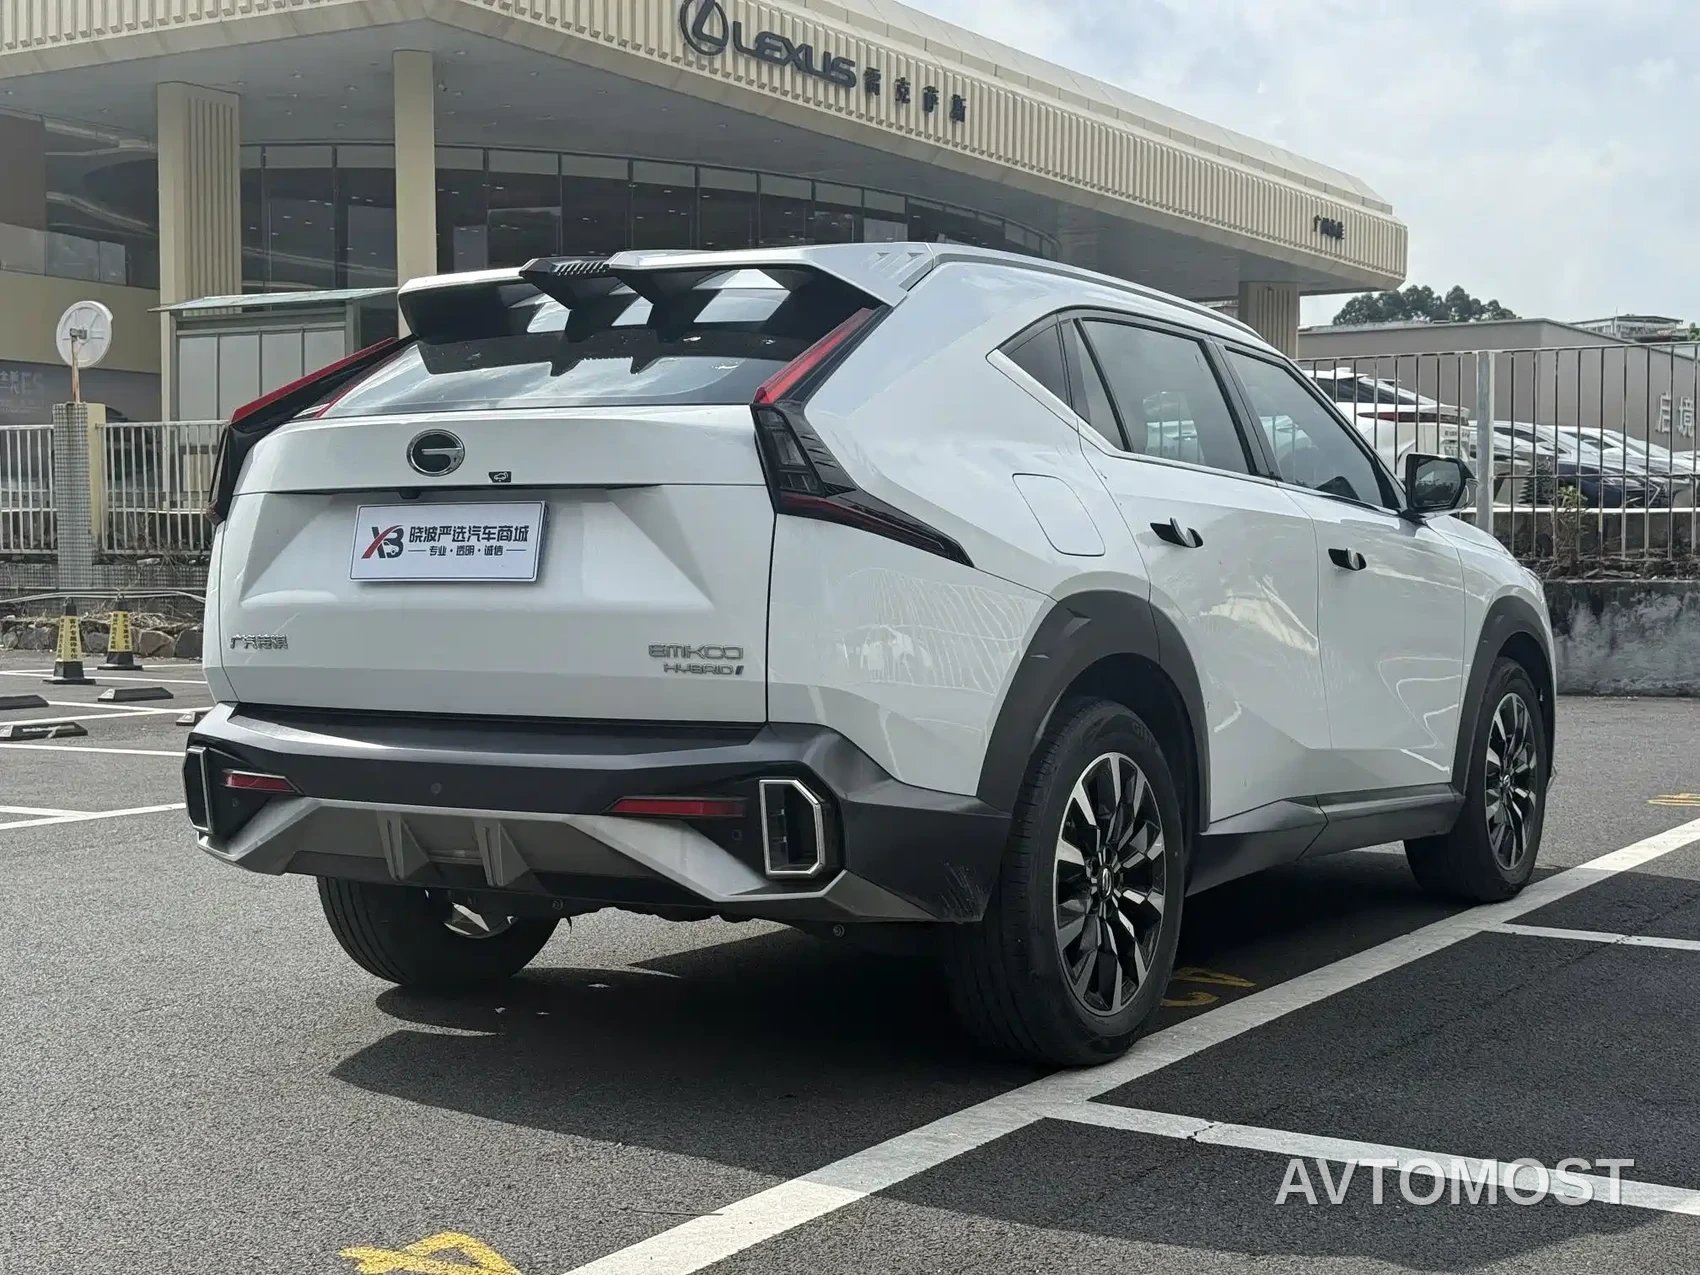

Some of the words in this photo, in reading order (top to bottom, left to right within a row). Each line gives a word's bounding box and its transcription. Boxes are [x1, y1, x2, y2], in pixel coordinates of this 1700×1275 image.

[732, 20, 857, 88] LEXUS
[409, 525, 530, 543] 晓波严选汽车商城
[648, 644, 744, 660] EMKOO
[663, 662, 733, 675] HYBRID
